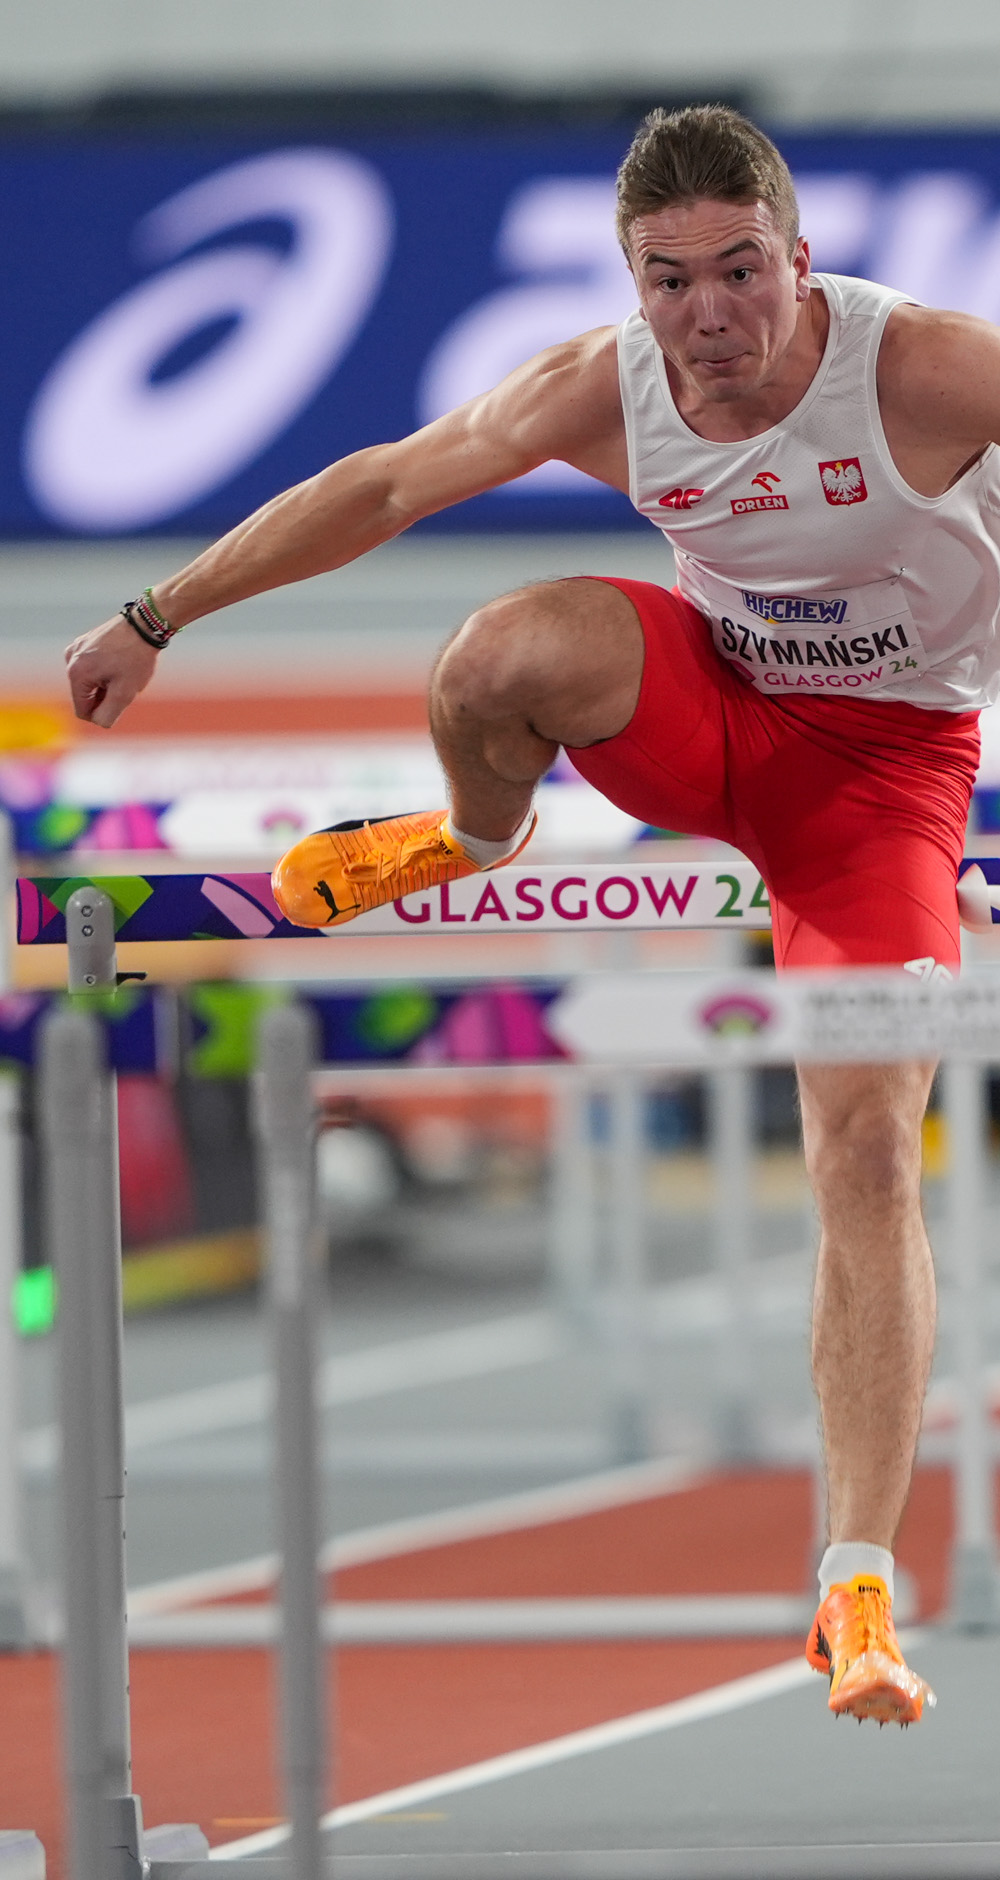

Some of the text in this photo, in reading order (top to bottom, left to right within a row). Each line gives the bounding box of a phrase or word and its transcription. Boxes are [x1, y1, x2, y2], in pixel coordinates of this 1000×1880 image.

[733, 496, 787, 513] ORLEN
[721, 616, 910, 667] SZYMAŃSKI
[763, 655, 918, 688] GLASGOW 24
[393, 875, 699, 924] GLASGOW
